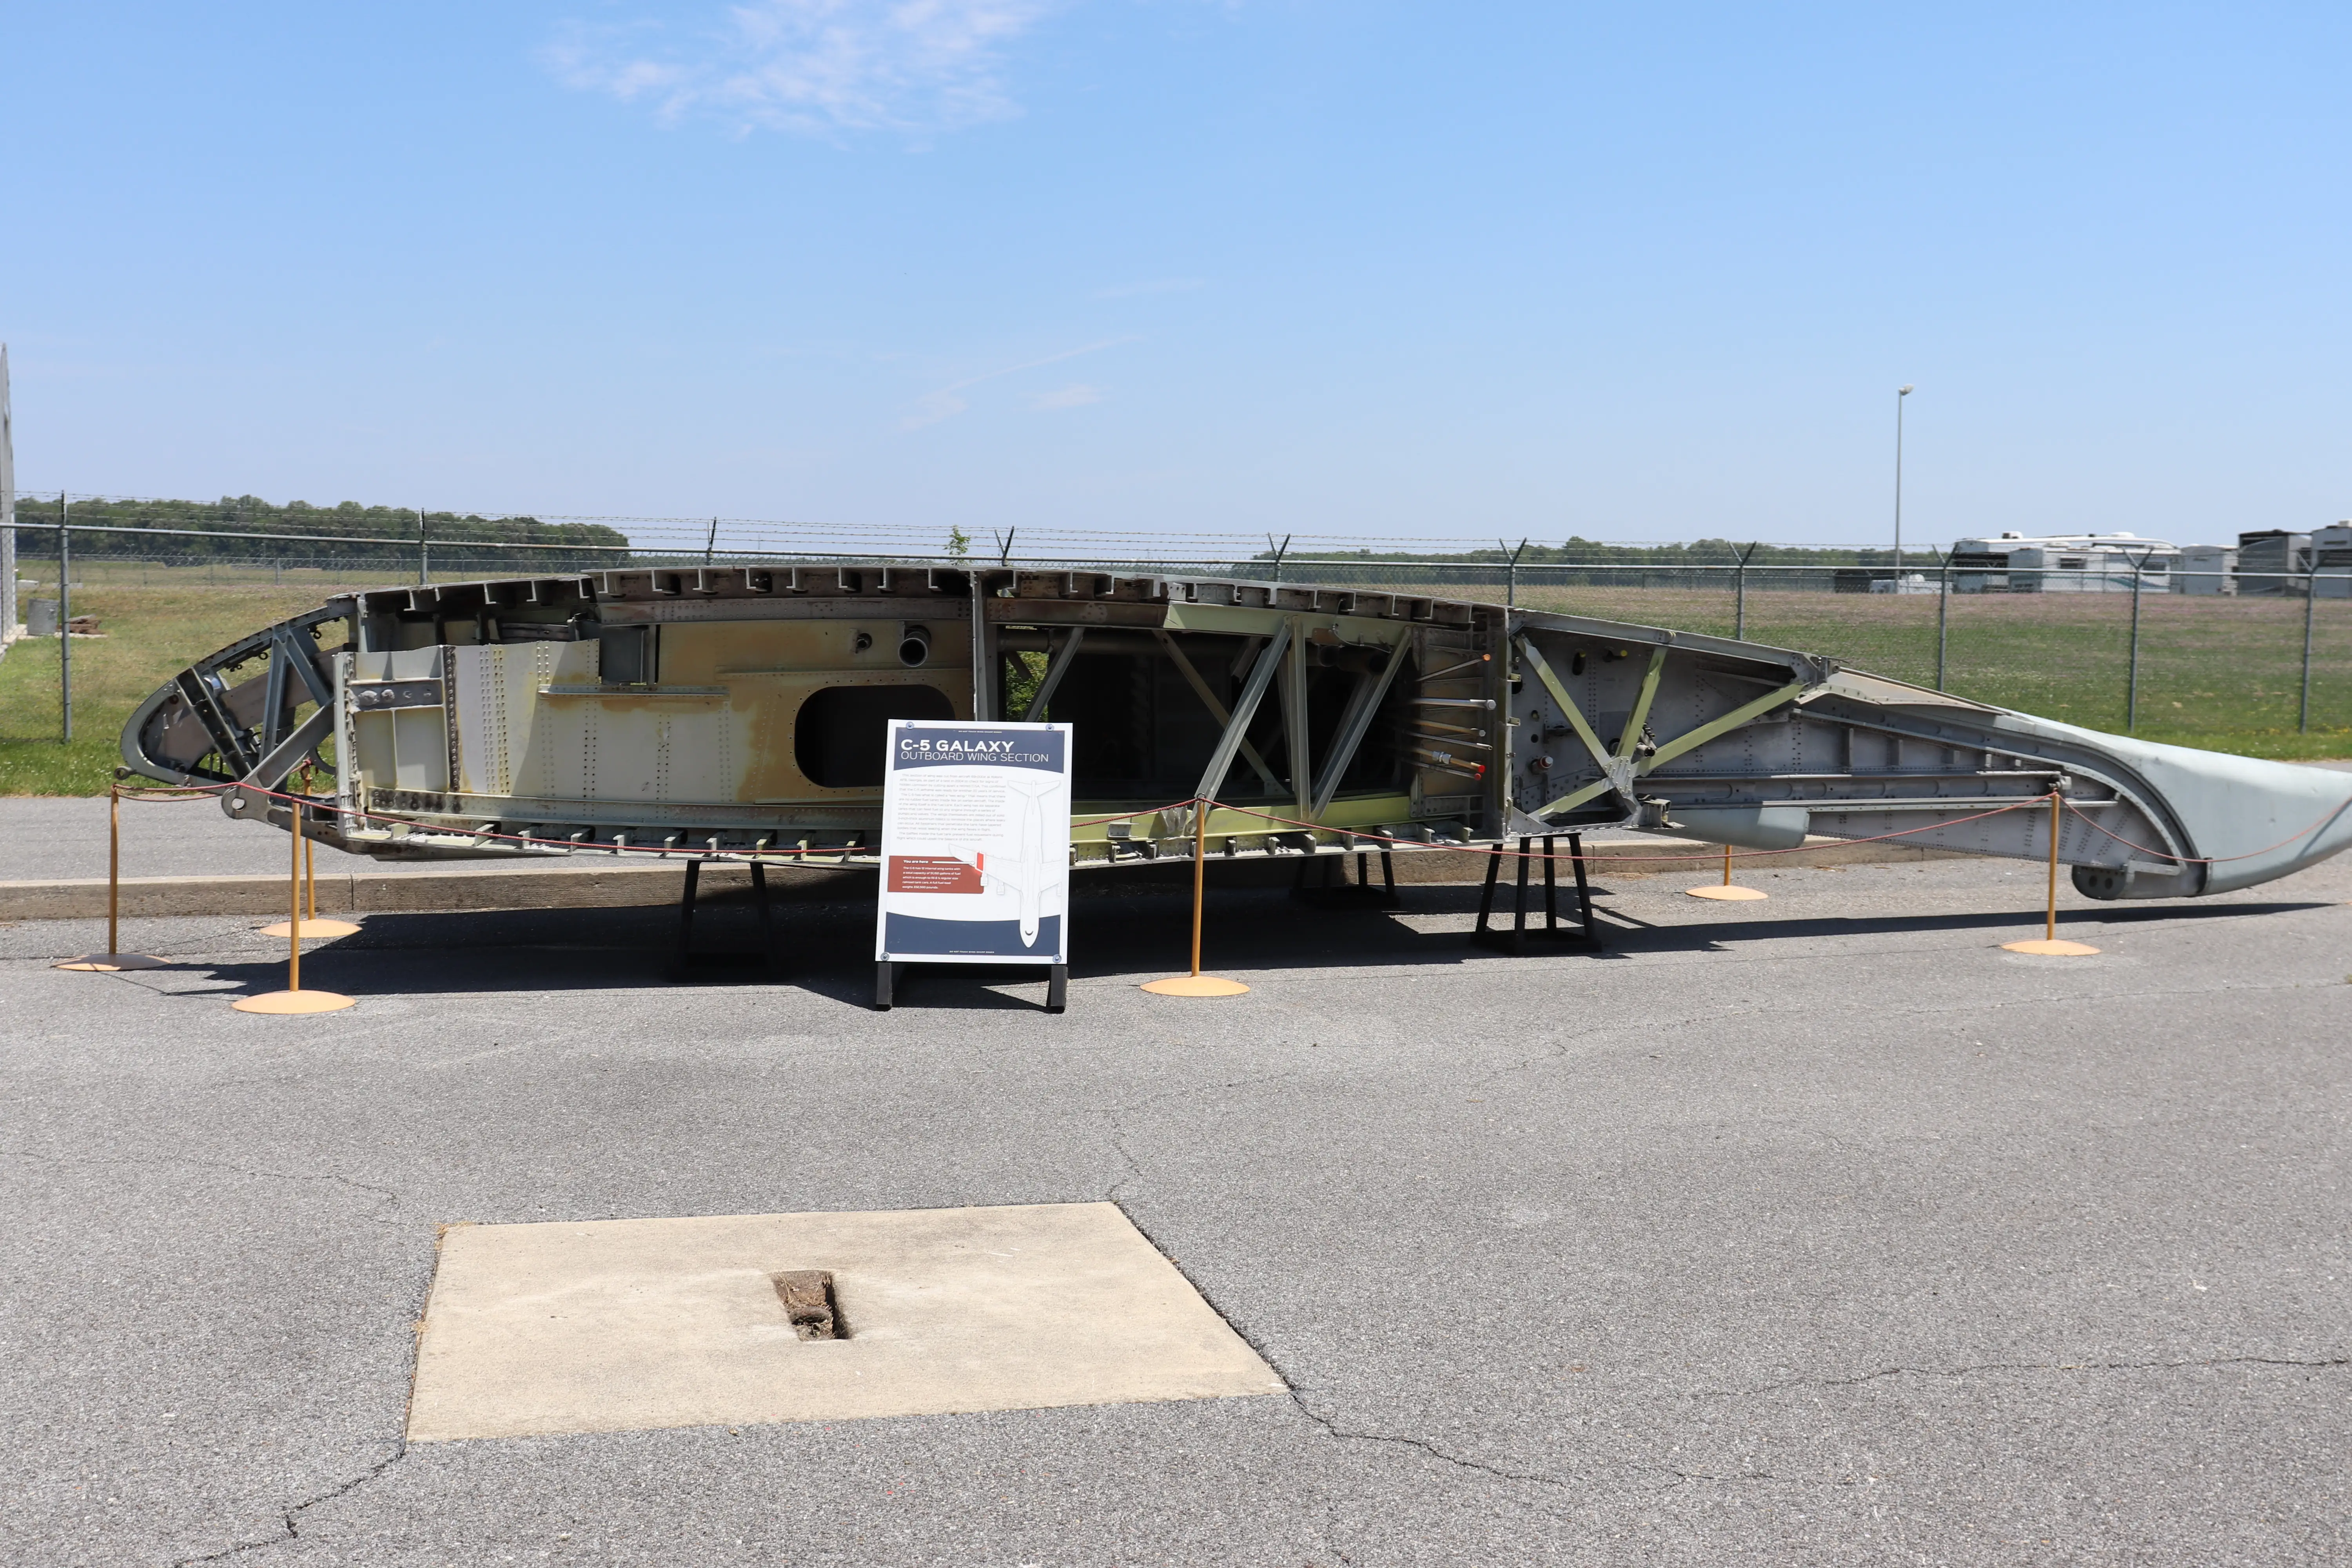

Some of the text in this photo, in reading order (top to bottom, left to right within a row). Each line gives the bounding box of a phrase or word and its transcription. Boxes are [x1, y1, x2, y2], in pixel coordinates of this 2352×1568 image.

[901, 739, 1013, 753] C-5 GALAXY
[901, 751, 1048, 762] OUTBOARD WING SECTION
